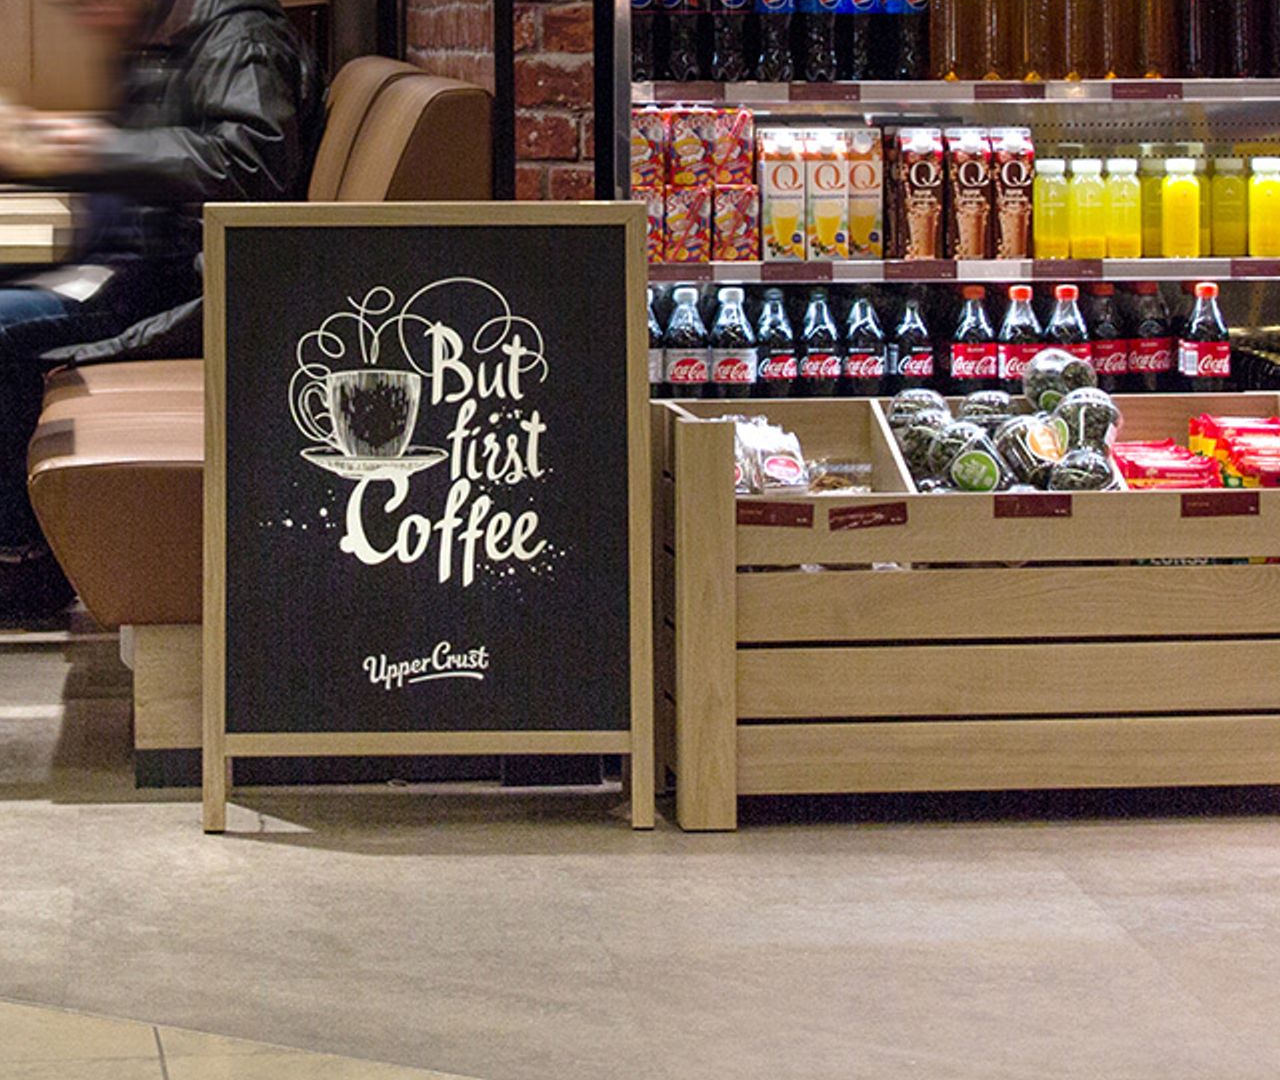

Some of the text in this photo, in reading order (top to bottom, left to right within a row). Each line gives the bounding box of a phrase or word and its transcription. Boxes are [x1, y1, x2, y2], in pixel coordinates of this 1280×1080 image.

[771, 163, 803, 191] Q
[814, 163, 846, 191] Q
[849, 163, 881, 191] Q
[910, 160, 942, 187] Q
[959, 160, 990, 187] Q
[1001, 160, 1033, 187] Q
[424, 321, 526, 404] But
[447, 398, 548, 487] first
[339, 469, 547, 587] Coffee
